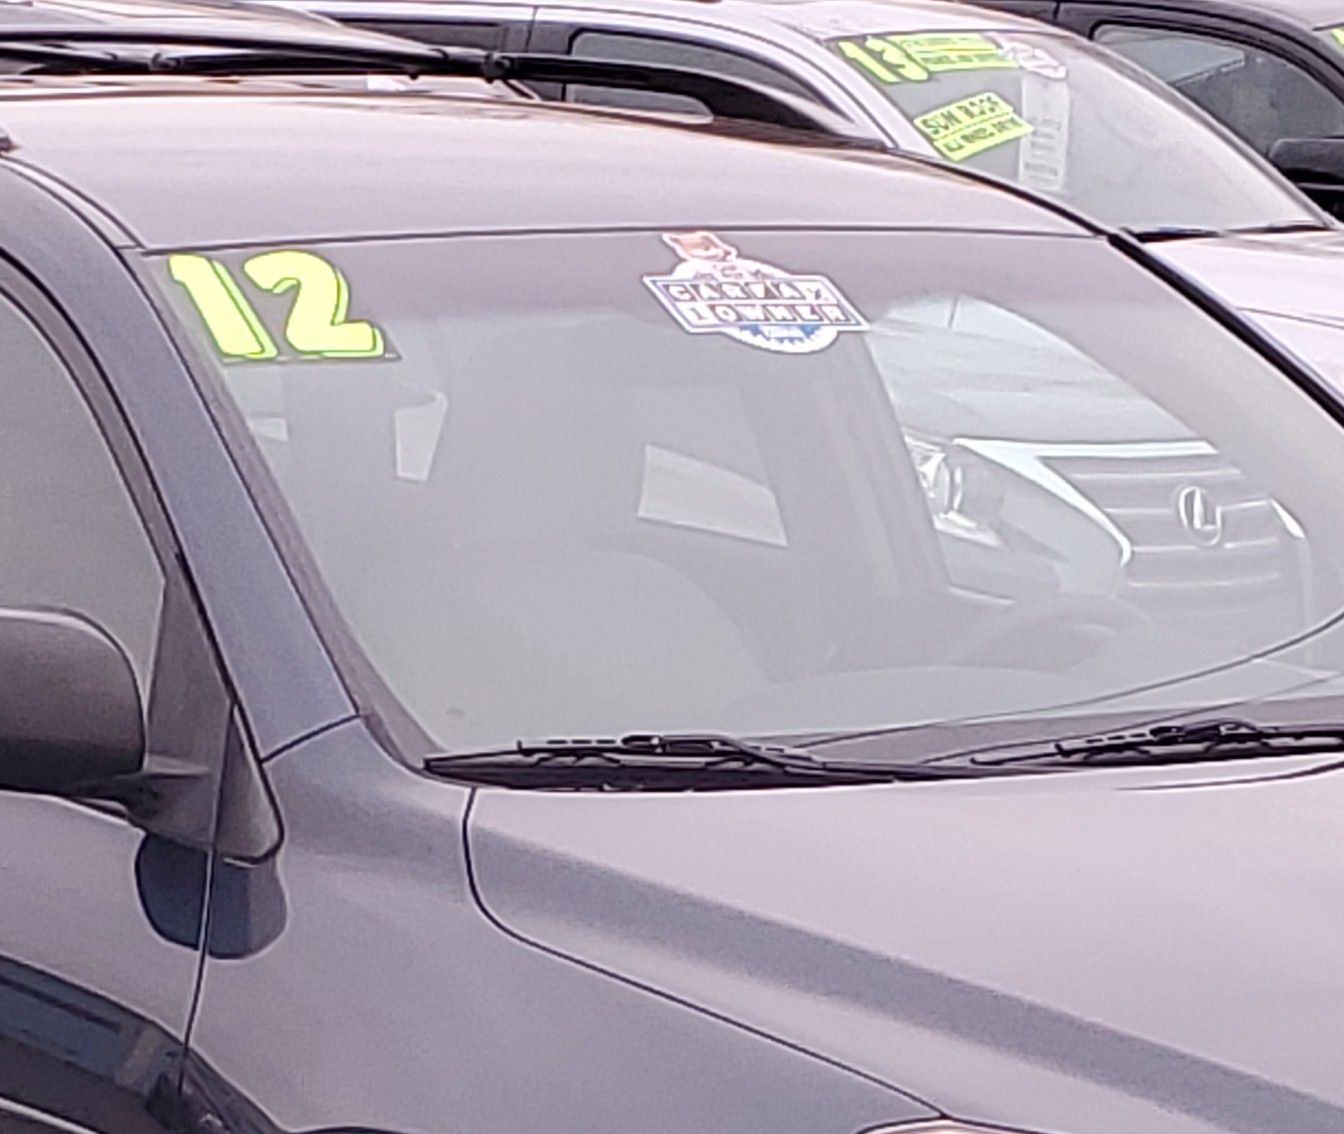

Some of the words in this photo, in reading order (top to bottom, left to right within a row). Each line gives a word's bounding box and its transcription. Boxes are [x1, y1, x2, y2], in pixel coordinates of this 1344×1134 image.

[837, 36, 930, 83] 13
[168, 250, 385, 359] 12
[664, 282, 837, 302] CARFAX
